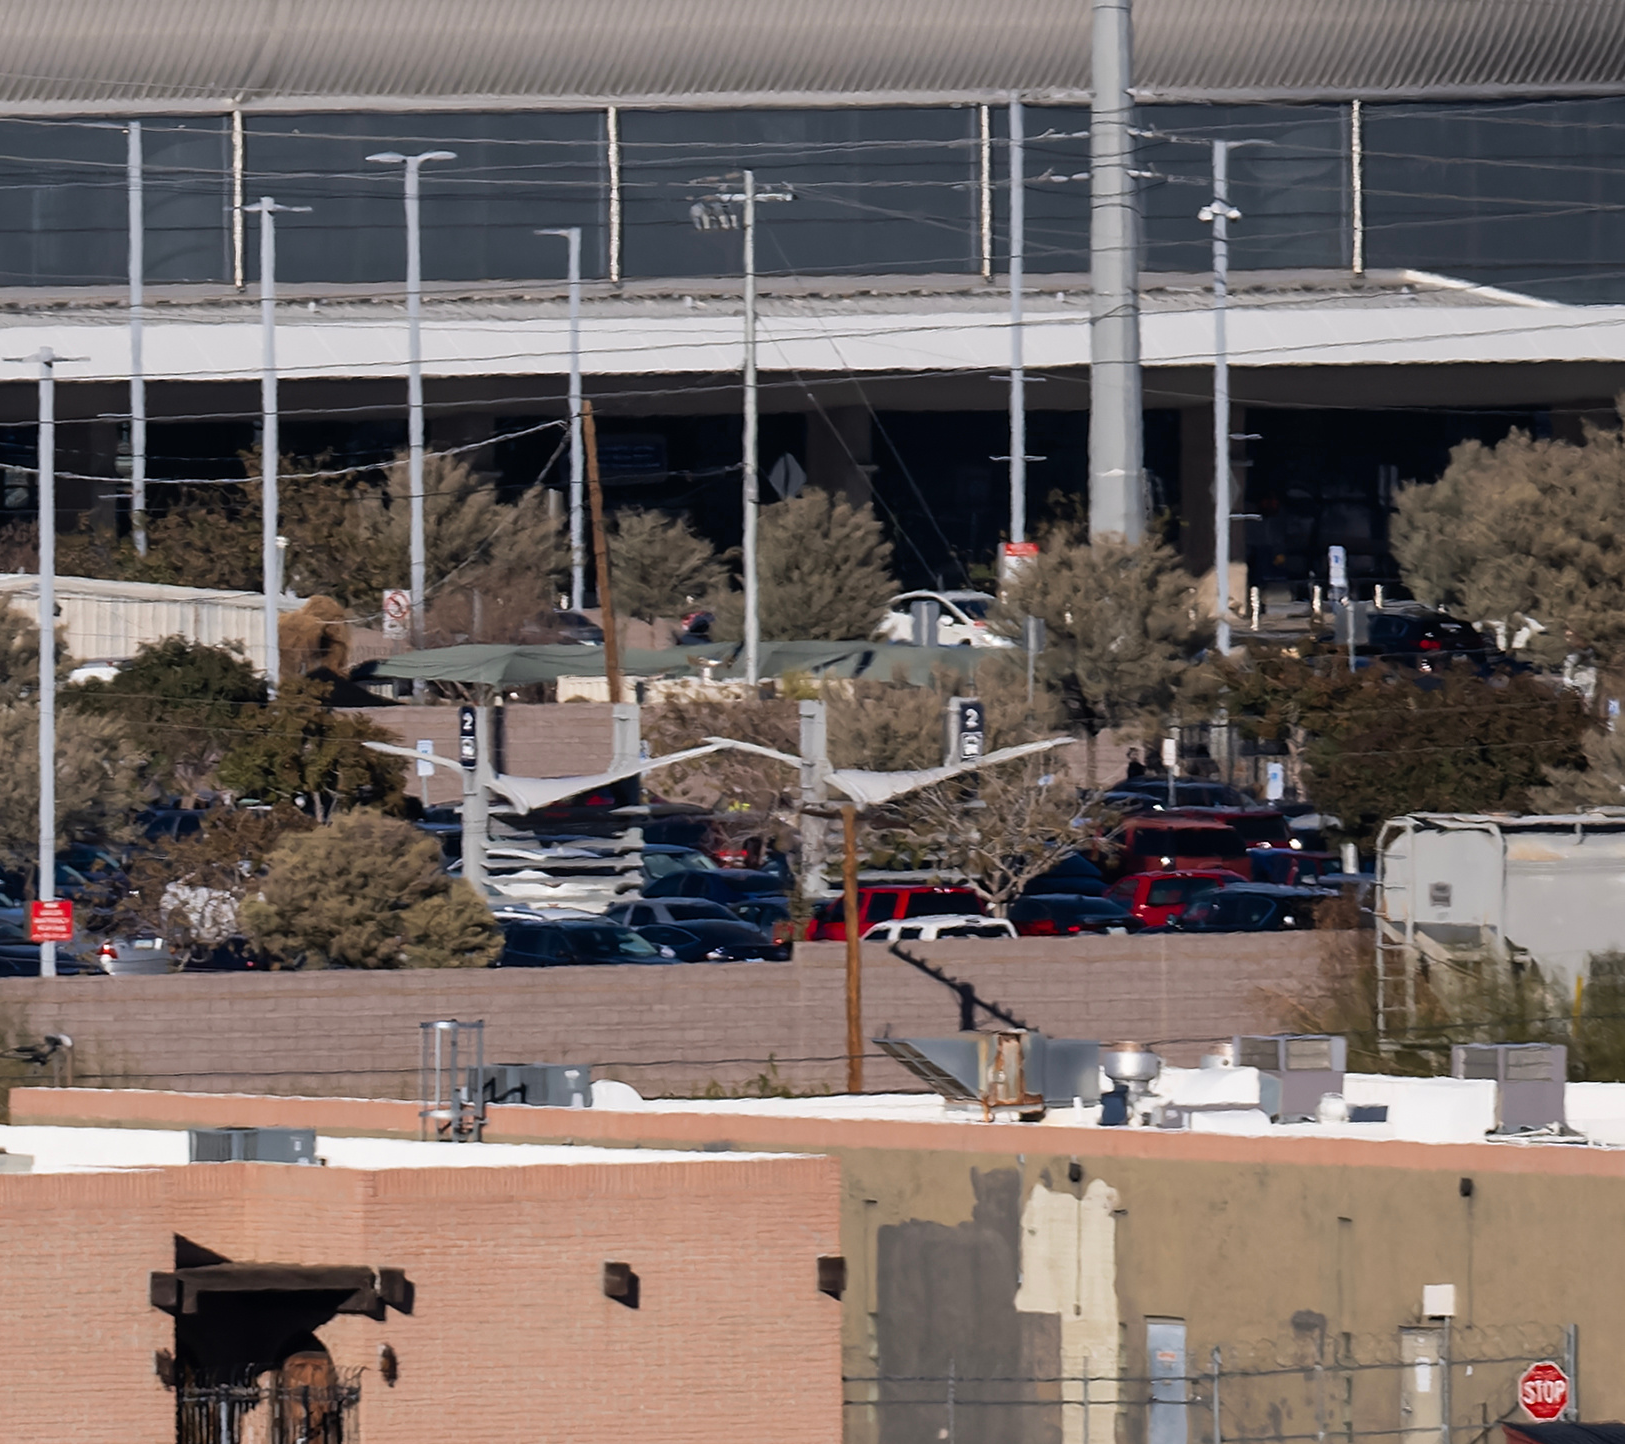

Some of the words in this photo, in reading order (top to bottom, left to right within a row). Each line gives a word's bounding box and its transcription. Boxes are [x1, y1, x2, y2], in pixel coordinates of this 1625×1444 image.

[462, 711, 474, 730] 2
[965, 707, 979, 729] 2
[1522, 1380, 1566, 1404] STOP
